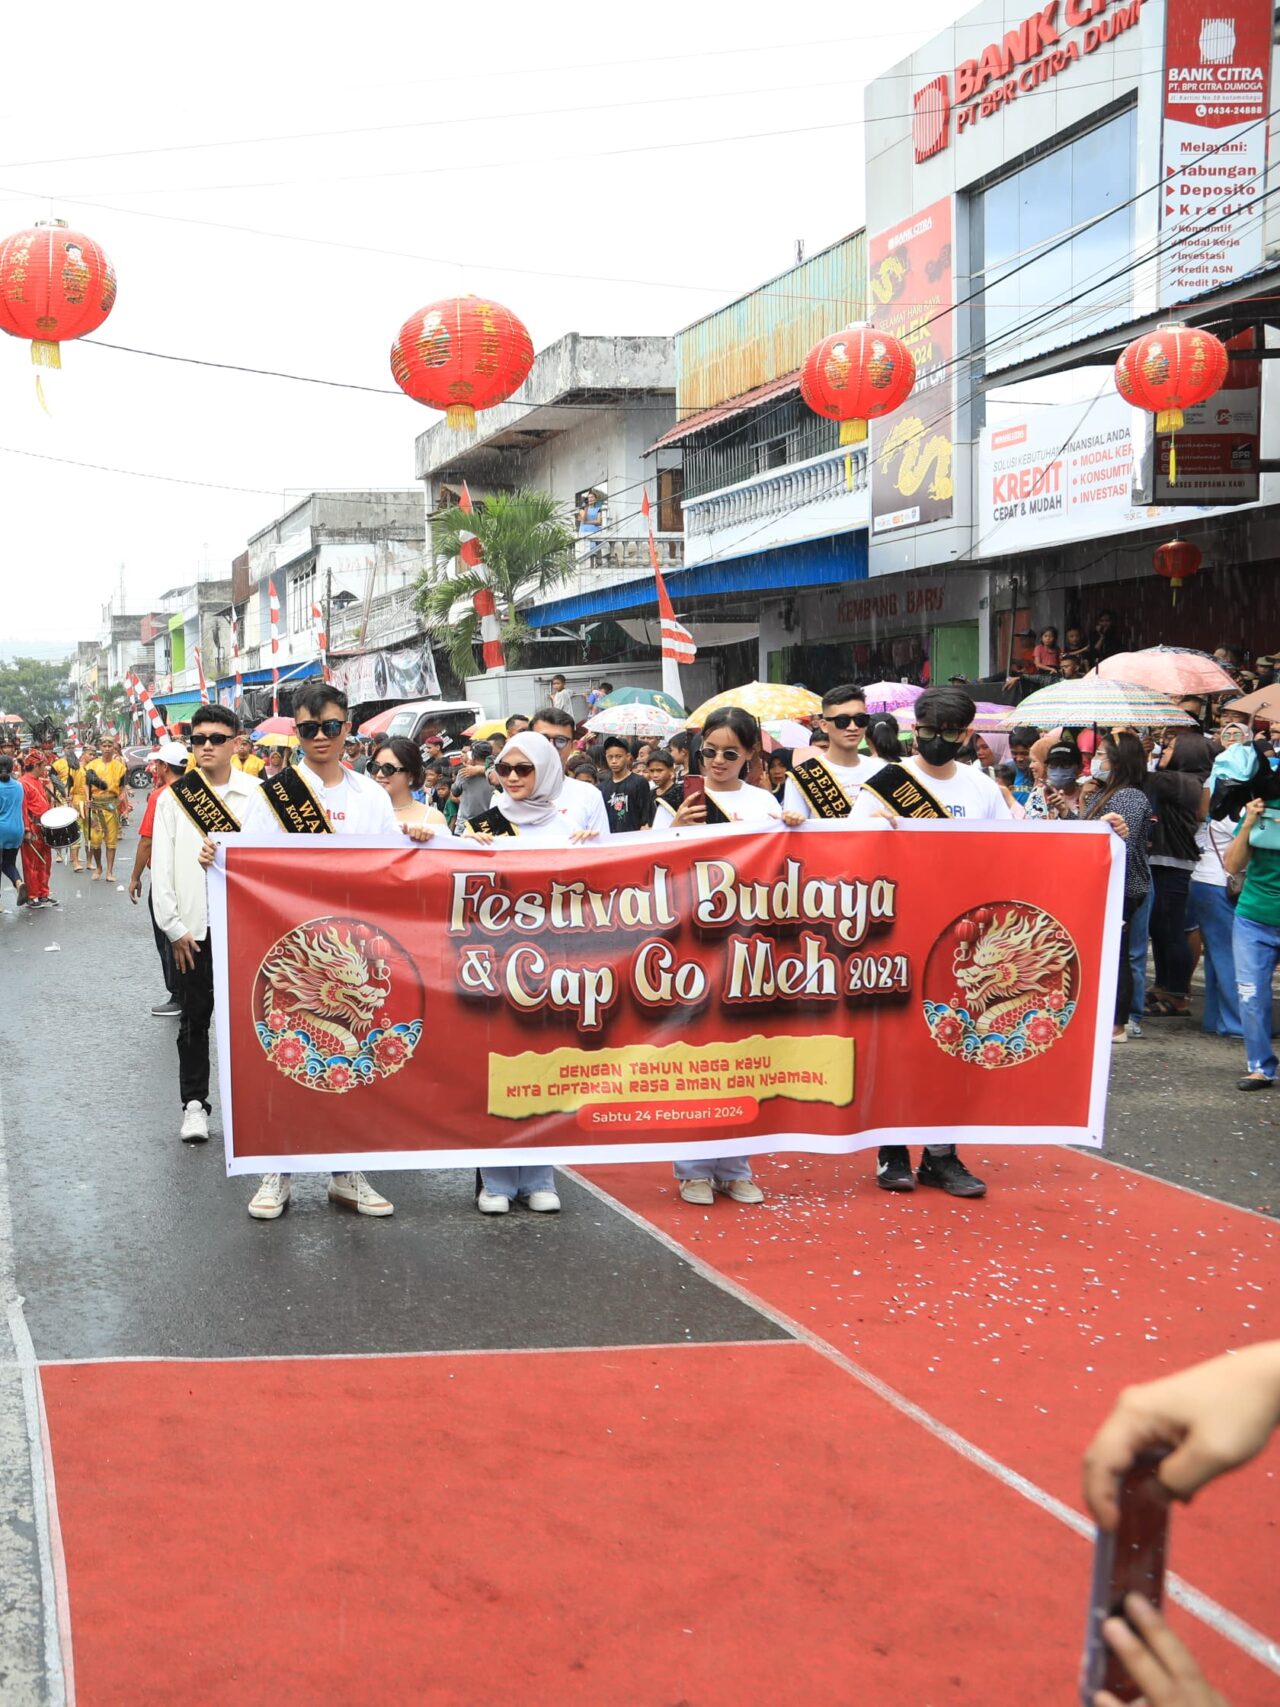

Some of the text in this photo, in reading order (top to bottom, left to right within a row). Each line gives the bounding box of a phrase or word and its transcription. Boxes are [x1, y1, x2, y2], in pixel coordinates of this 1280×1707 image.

[955, 0, 1060, 105] BANK
[1169, 67, 1263, 81] BANK CITRA
[956, 103, 978, 134] PT
[980, 79, 1017, 119] BPR
[1019, 40, 1080, 93] CITRA
[1182, 83, 1197, 91] BPR
[1199, 82, 1222, 90] CITRA
[1224, 82, 1262, 91] DUMOGA
[1181, 142, 1247, 155] Melayani:
[1181, 165, 1257, 179] Tabungan
[1180, 184, 1256, 198] Deposito
[1177, 252, 1226, 260] Investasi
[1177, 265, 1233, 274] Kredit ASN
[1177, 279, 1209, 287] Kredit
[1107, 427, 1131, 443] ANDA
[1080, 447, 1113, 467] MODAL
[992, 460, 1063, 505] KREDIT
[1080, 483, 1127, 504] INVESTASI
[993, 504, 1018, 521] CEPAT
[1021, 502, 1027, 516] &
[1029, 494, 1062, 515] MUDAH
[450, 858, 896, 941] Festival Budaya
[462, 936, 909, 1026] & Cap Go Meh 2024
[592, 1106, 744, 1123] Sabtu 24 Februari 2024
